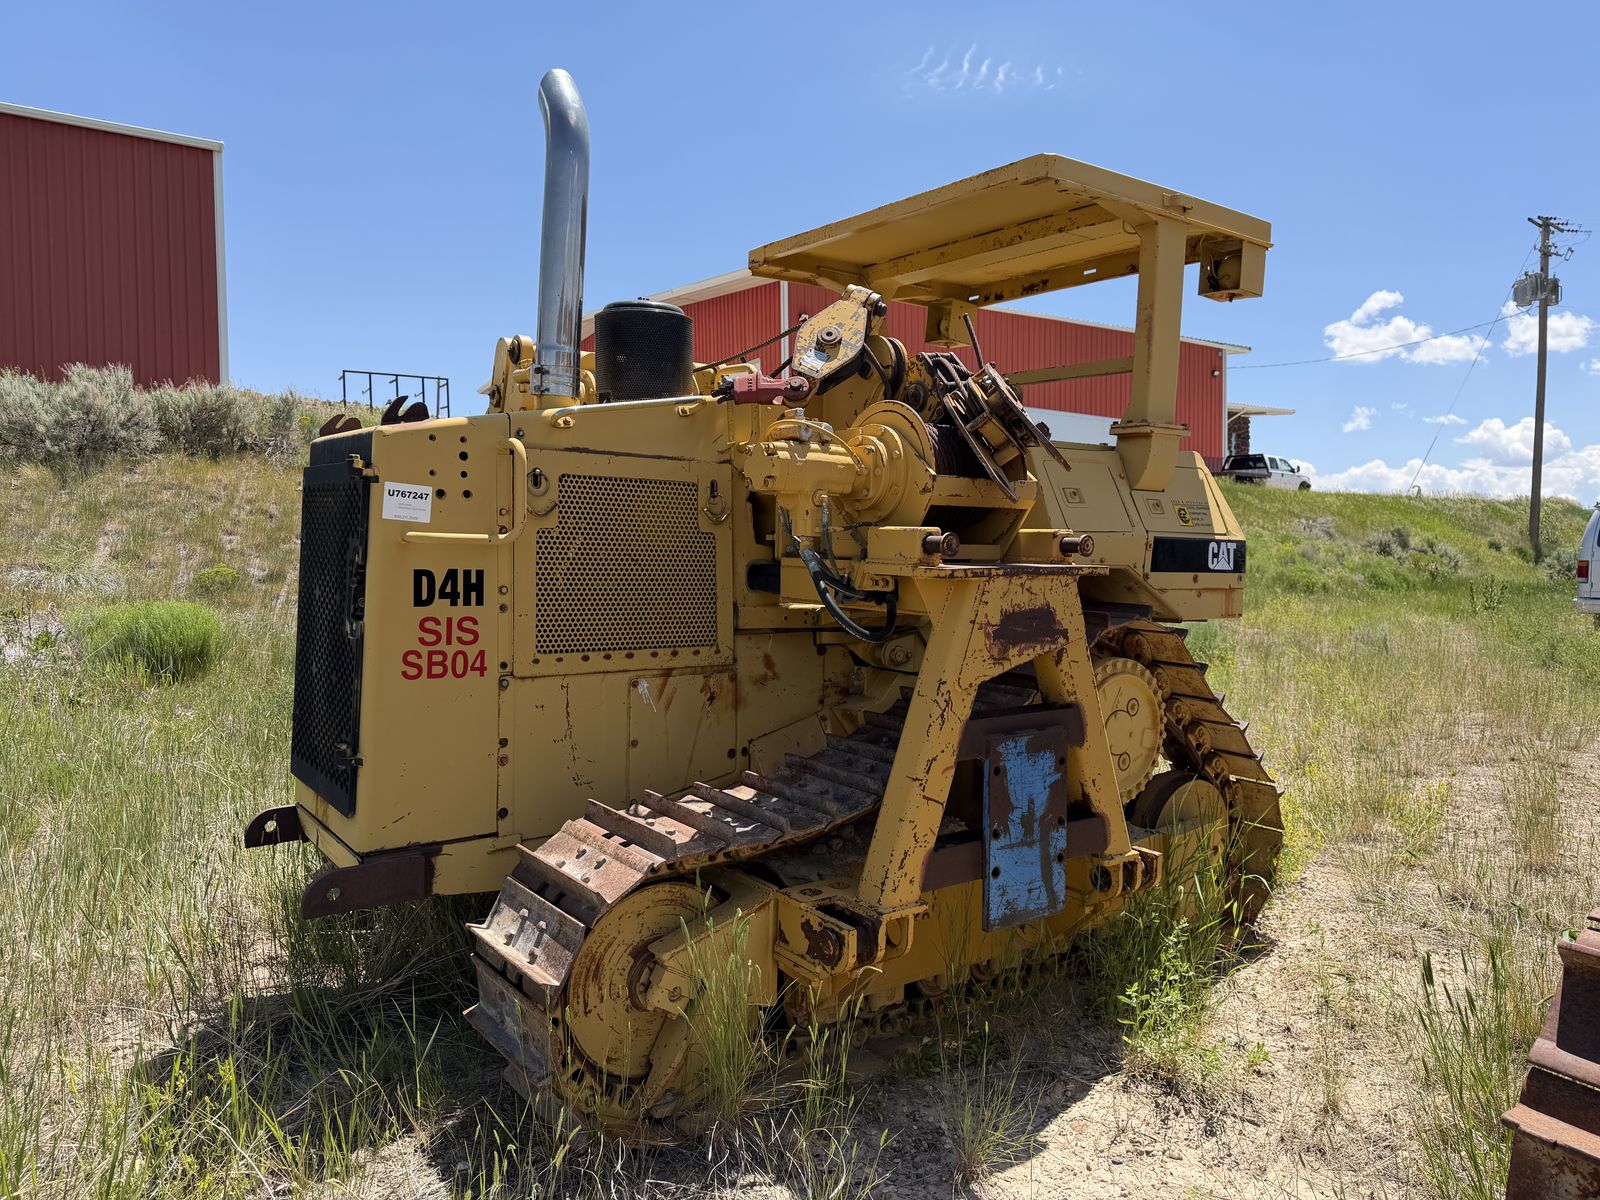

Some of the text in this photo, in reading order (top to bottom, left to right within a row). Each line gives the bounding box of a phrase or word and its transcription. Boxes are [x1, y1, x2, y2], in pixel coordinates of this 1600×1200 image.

[388, 489, 429, 500] U767247
[1208, 541, 1237, 570] CAT
[413, 568, 484, 607] D4H
[418, 616, 480, 646] SIS
[401, 649, 487, 680] SB04
